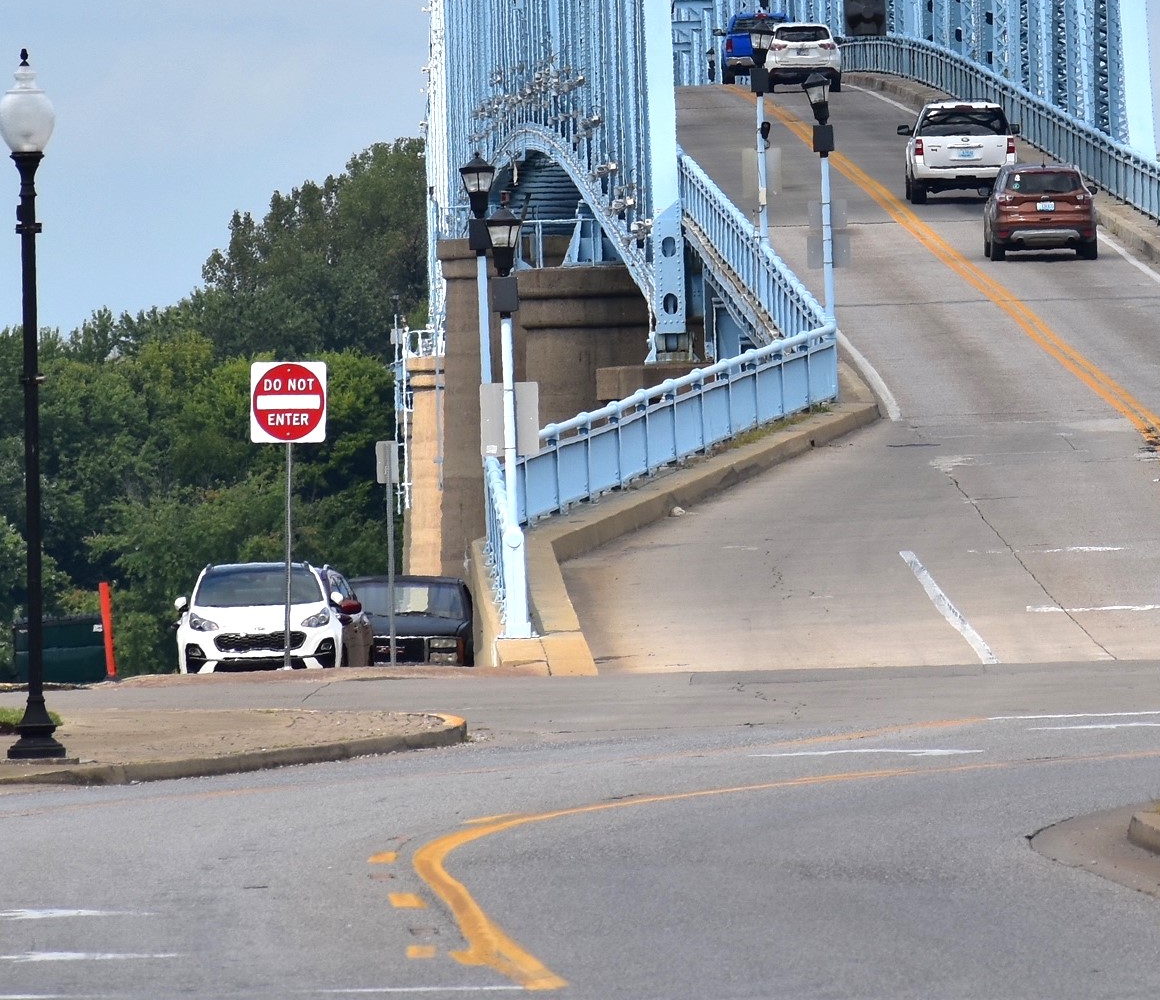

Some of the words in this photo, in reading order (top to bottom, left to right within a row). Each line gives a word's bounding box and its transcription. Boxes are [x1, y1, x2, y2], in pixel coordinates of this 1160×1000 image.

[264, 378, 282, 391] DO
[288, 378, 315, 391] NOT
[268, 413, 309, 426] ENTER
